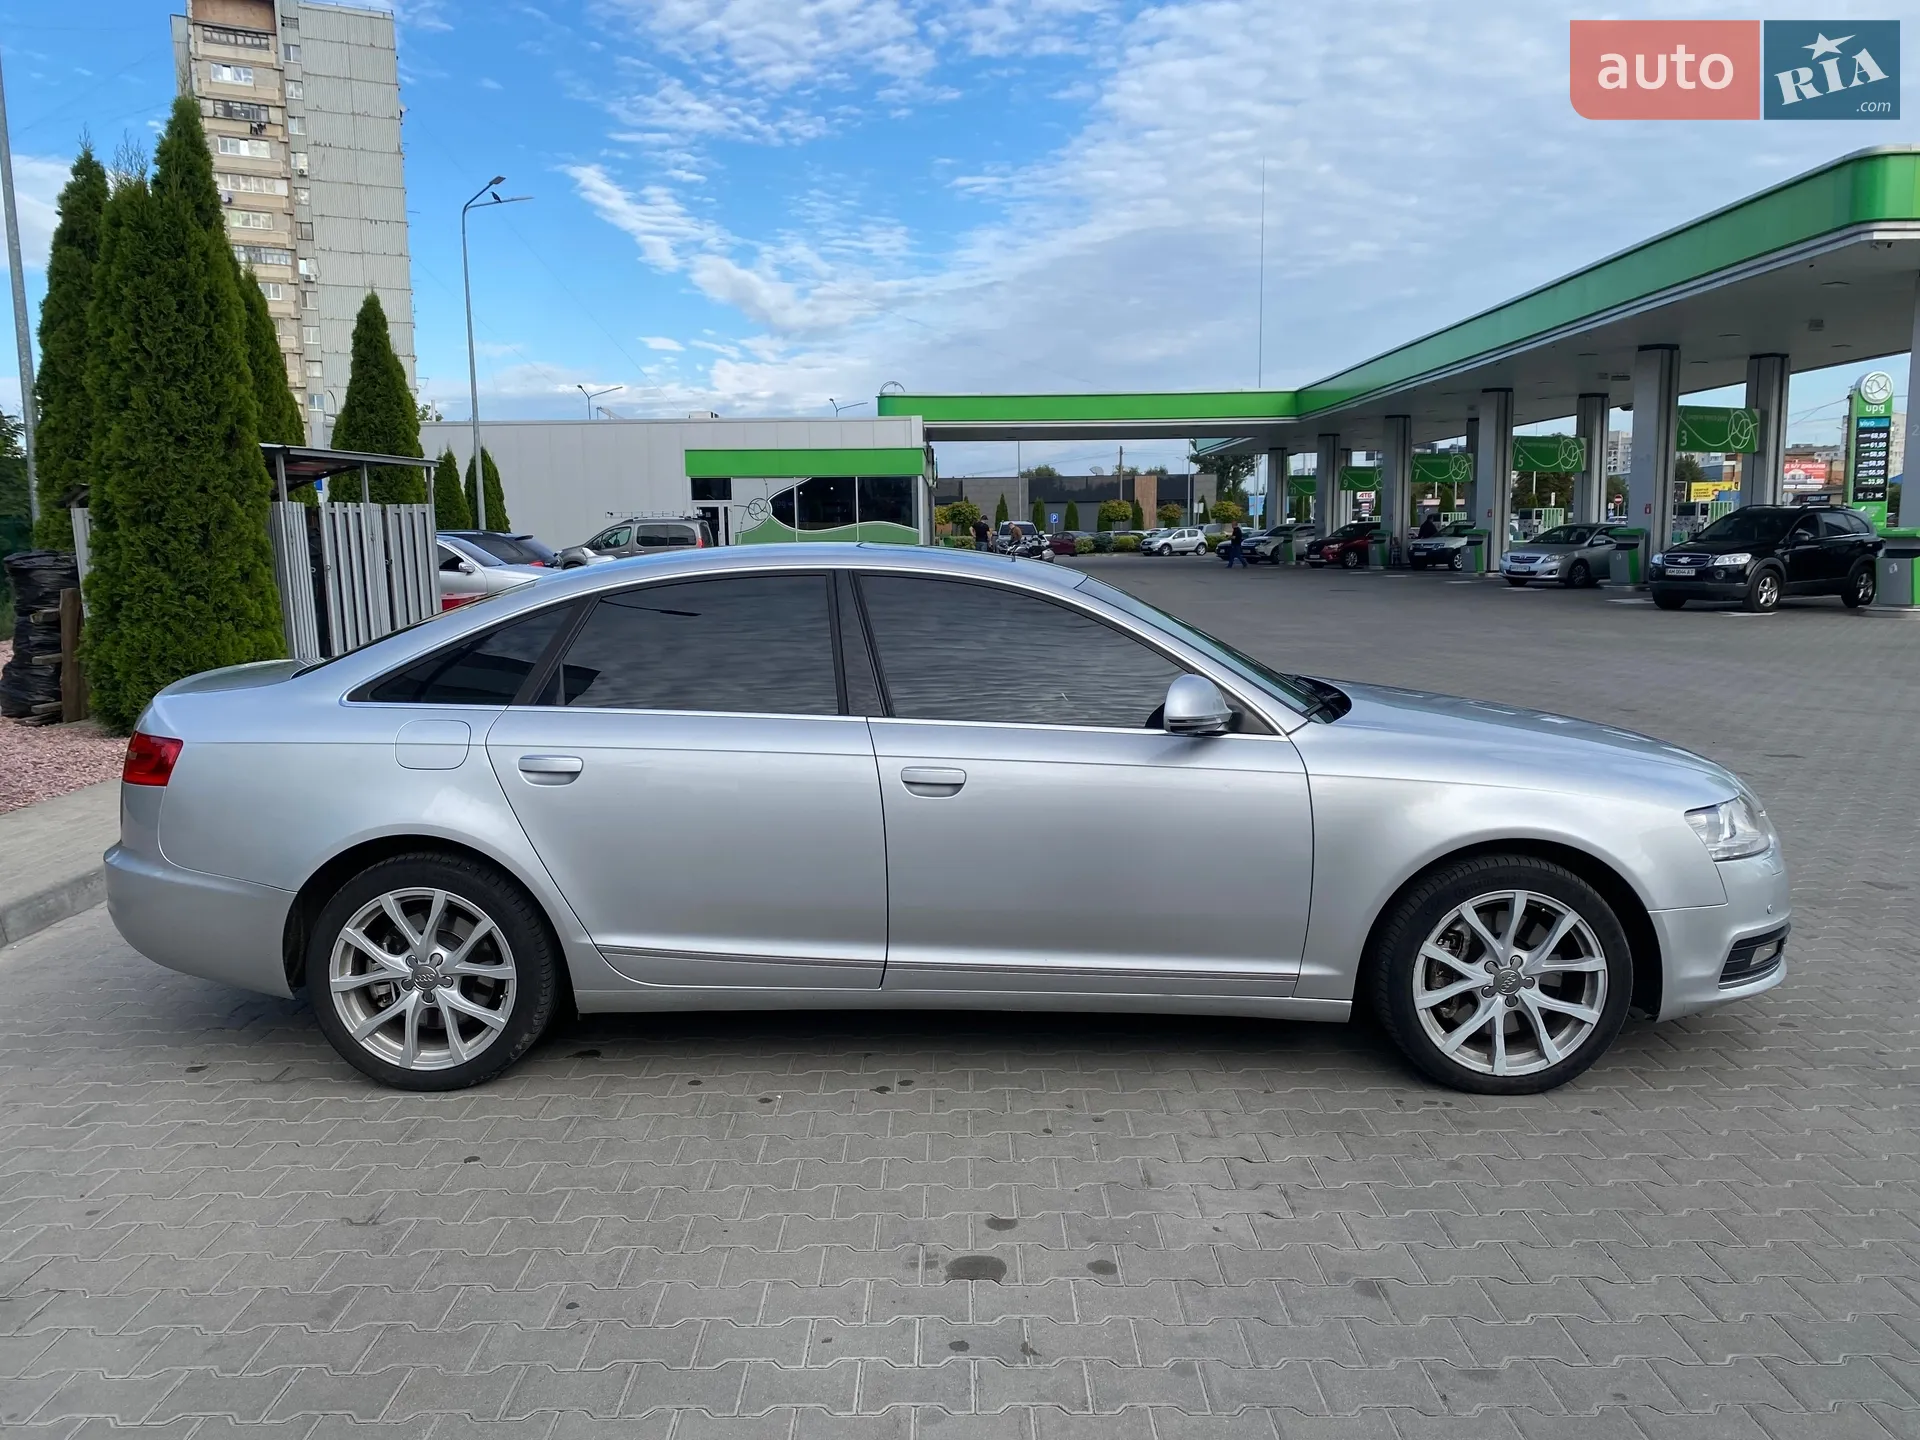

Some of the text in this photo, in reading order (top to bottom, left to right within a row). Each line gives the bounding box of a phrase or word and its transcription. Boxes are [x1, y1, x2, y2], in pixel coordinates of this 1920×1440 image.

[1865, 405, 1885, 414] upg
[1679, 429, 1688, 447] 3
[1517, 454, 1525, 468] 5
[1414, 469, 1421, 480] 7
[1343, 479, 1349, 488] 9
[1290, 487, 1297, 495] 11
